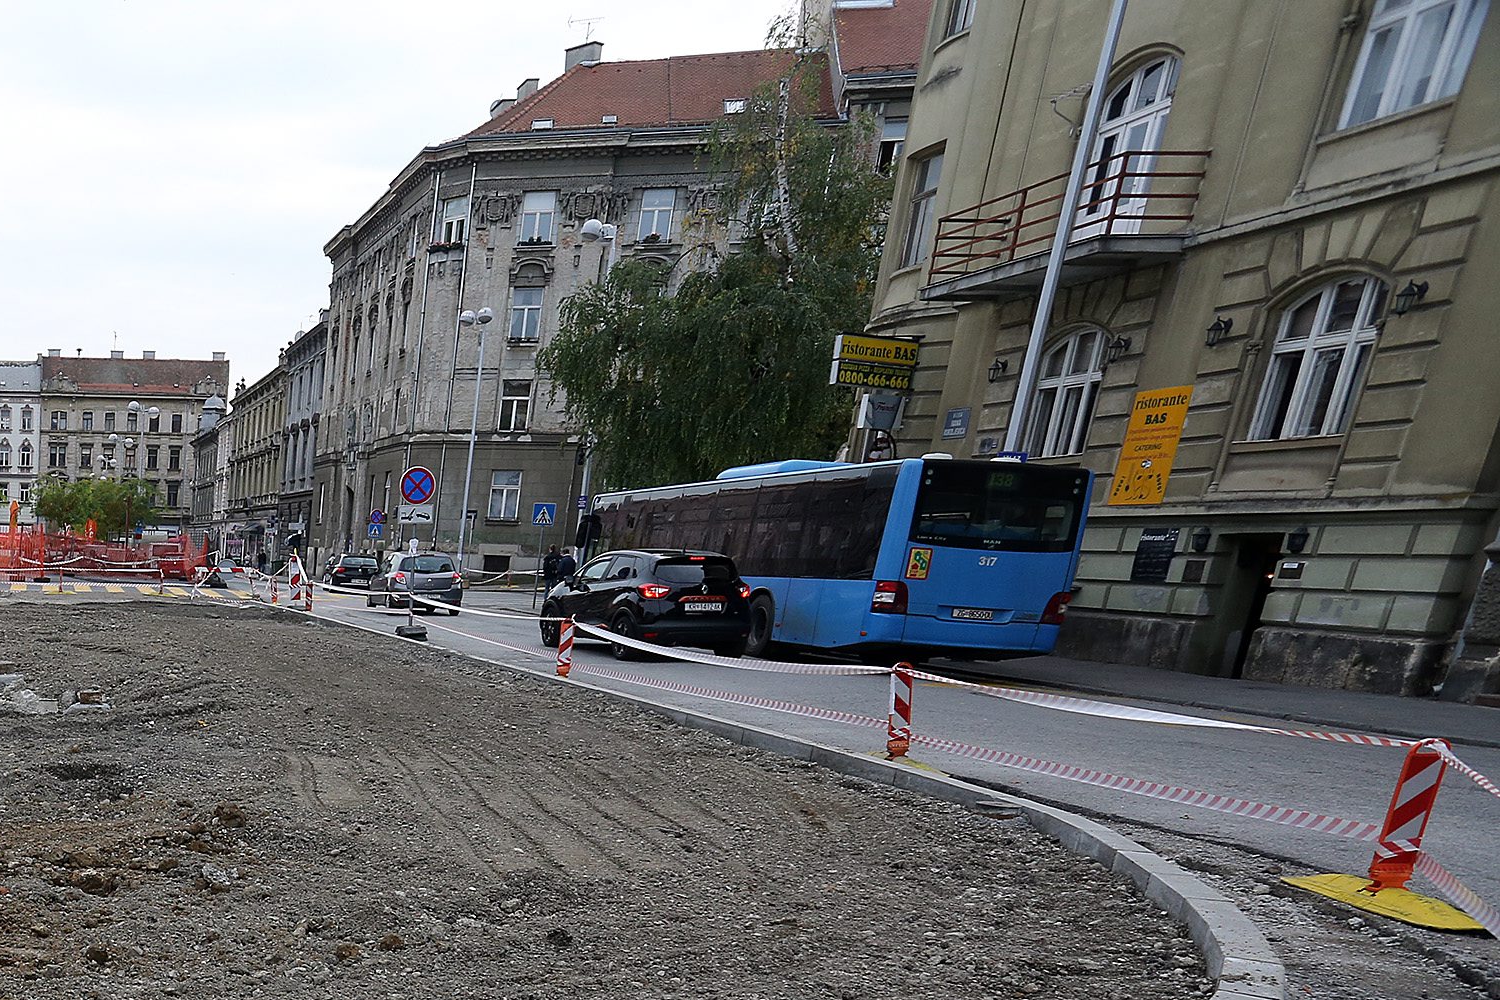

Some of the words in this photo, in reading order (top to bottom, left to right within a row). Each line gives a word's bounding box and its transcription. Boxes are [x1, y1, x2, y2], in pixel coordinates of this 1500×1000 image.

[841, 341, 892, 359] ristorante
[893, 346, 917, 361] BAS
[1135, 394, 1188, 410] ristorante
[1144, 412, 1168, 425] BAS
[1134, 443, 1162, 452] CATERING
[978, 556, 998, 567] 317
